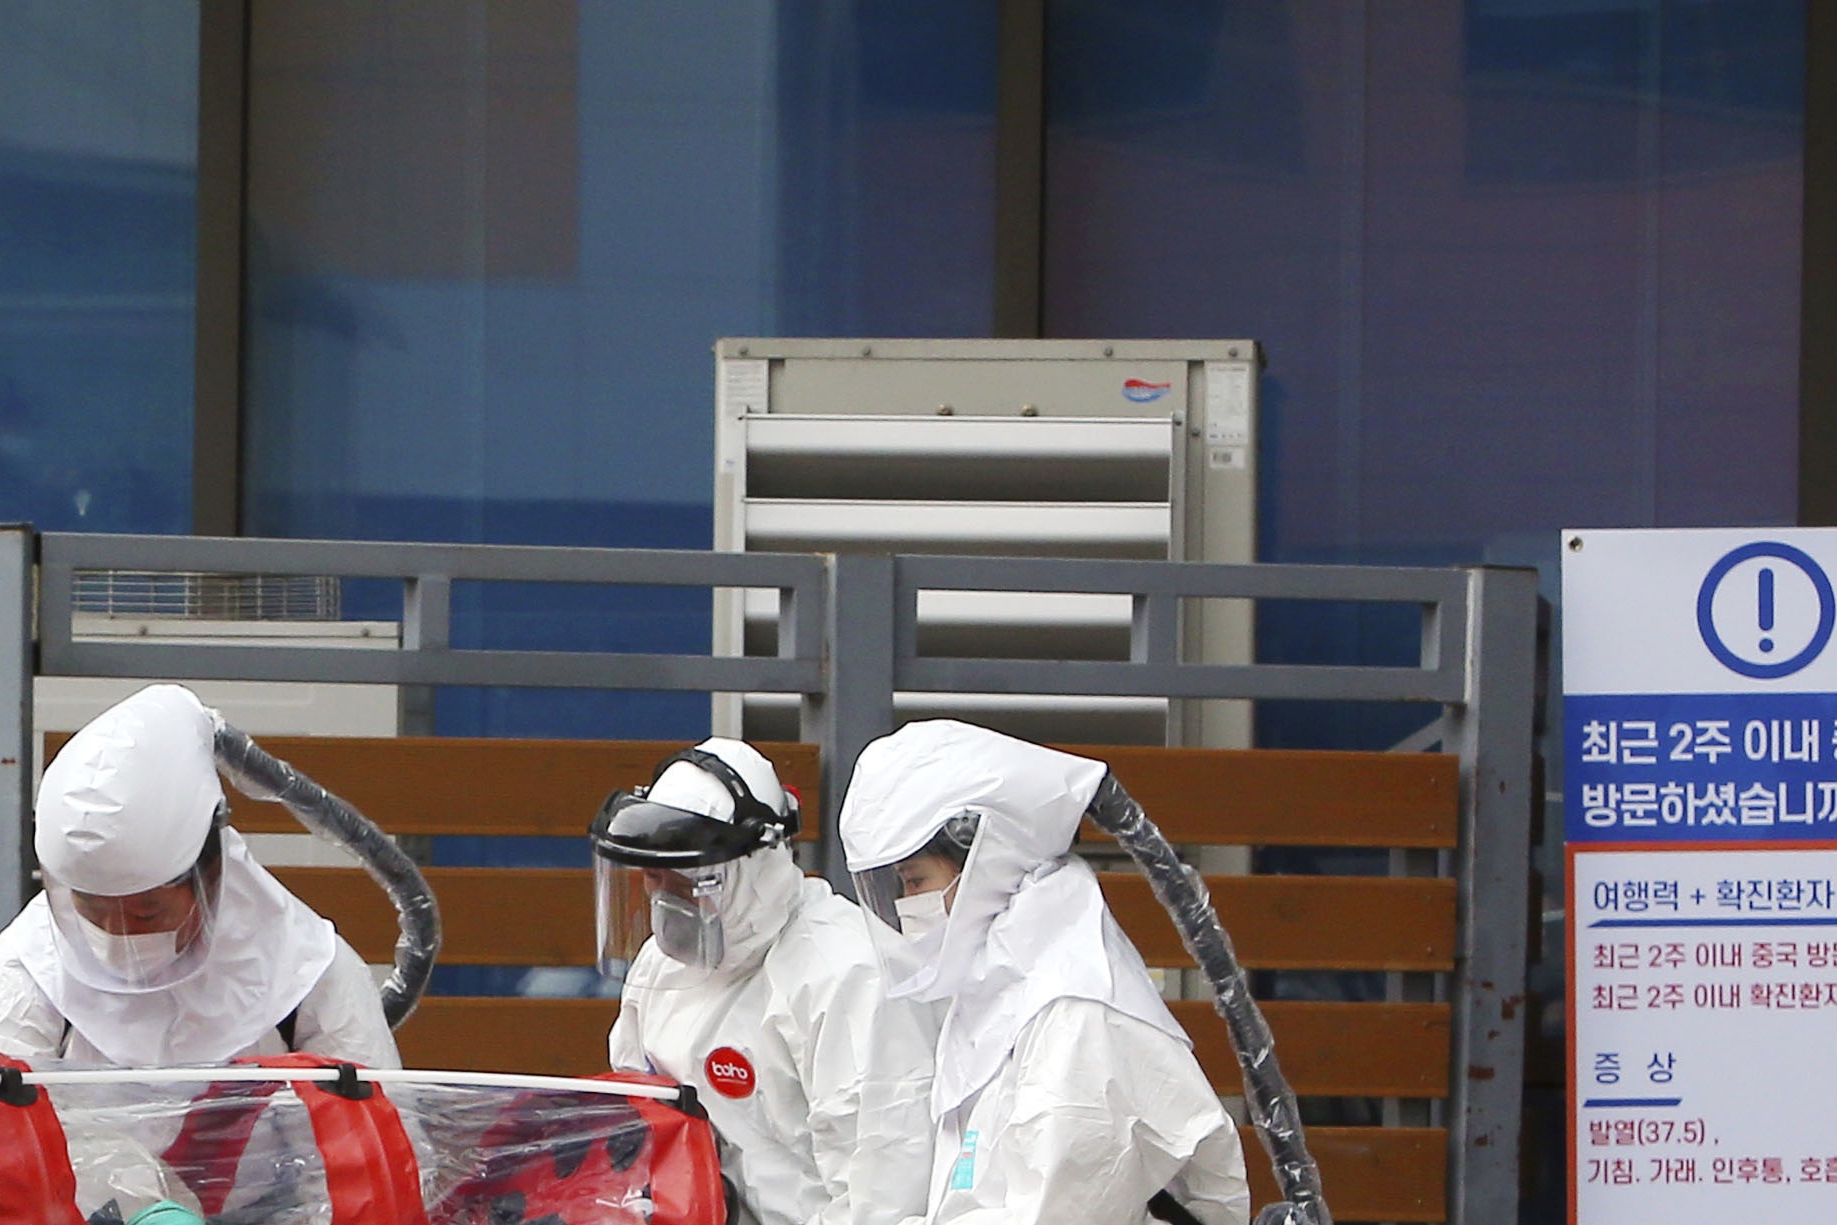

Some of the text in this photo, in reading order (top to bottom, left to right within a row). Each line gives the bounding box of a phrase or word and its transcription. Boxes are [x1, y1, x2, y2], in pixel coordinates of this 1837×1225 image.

[1582, 720, 1658, 764] 최근
[1669, 720, 1732, 764] 2주
[1744, 719, 1820, 763] 이내
[1593, 881, 1679, 912] 여행력
[1716, 879, 1835, 911] 확진환자
[1593, 942, 1837, 969] 최근 2주 이내 중국 방
[1592, 984, 1639, 1010] 최근
[1647, 984, 1685, 1009] 2주
[1694, 984, 1741, 1009] 이내
